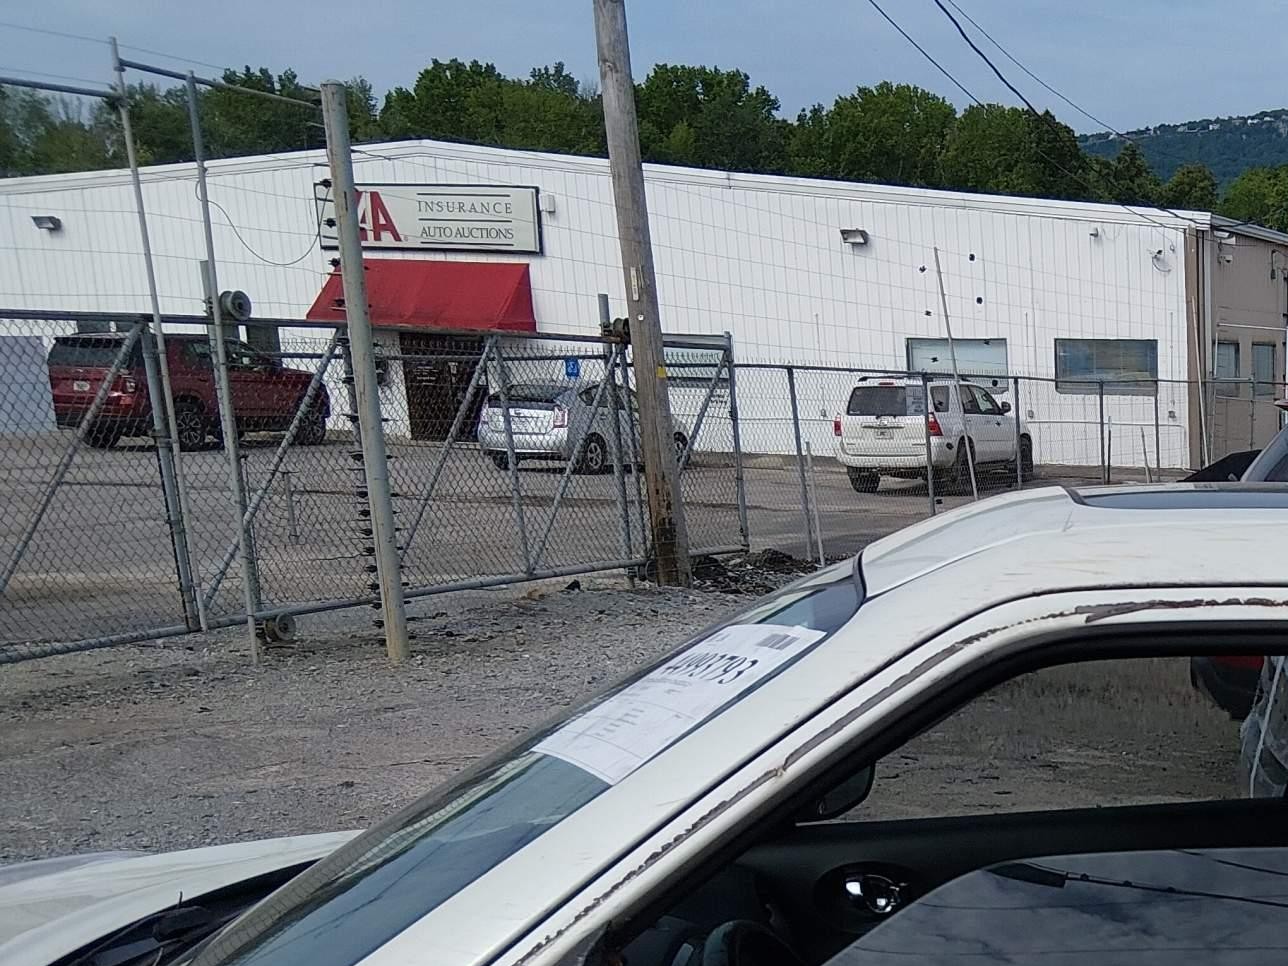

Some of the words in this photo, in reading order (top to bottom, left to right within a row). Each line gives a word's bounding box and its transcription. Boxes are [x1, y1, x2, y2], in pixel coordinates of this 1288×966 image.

[417, 200, 513, 214] INSURANCE
[420, 226, 453, 238] AUTO
[454, 227, 514, 240] AUCTIONS
